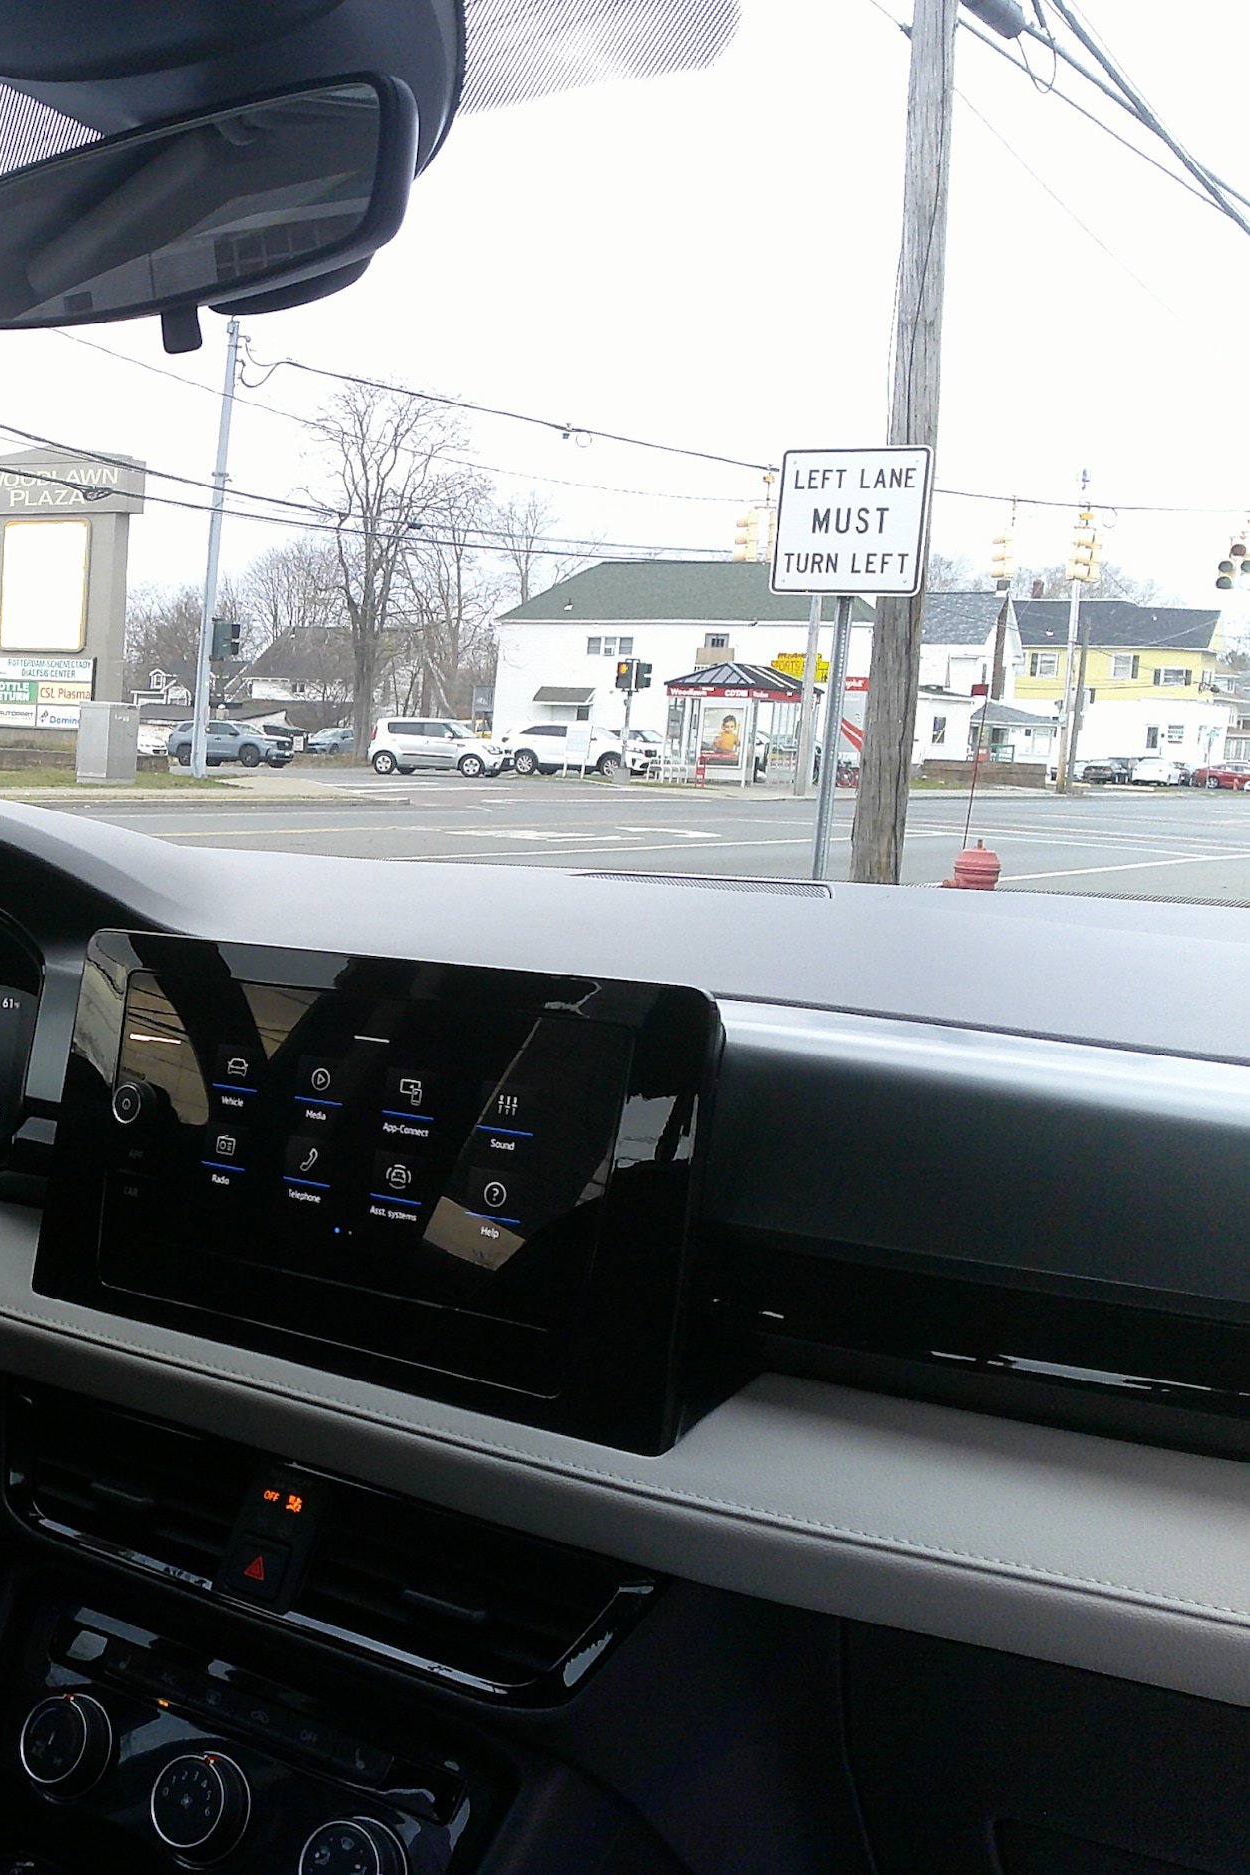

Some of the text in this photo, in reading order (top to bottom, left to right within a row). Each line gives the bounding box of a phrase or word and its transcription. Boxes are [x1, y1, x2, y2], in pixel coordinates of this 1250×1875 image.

[794, 468, 917, 489] LEFT LANE
[9, 488, 86, 507] PLAZA
[811, 507, 890, 535] MUST
[784, 553, 909, 574] TURN LEFT
[50, 669, 76, 678] CENTER
[40, 687, 91, 700] CSL Plasma
[221, 1095, 245, 1108] Vehicle
[305, 1109, 327, 1121] Media
[382, 1121, 430, 1138] App-Connect
[490, 1138, 516, 1151] Sound
[211, 1173, 230, 1186] Radio
[288, 1188, 322, 1204] Telephone
[387, 1209, 418, 1222] systems
[480, 1226, 500, 1240] Help
[263, 1490, 281, 1502] OFF
